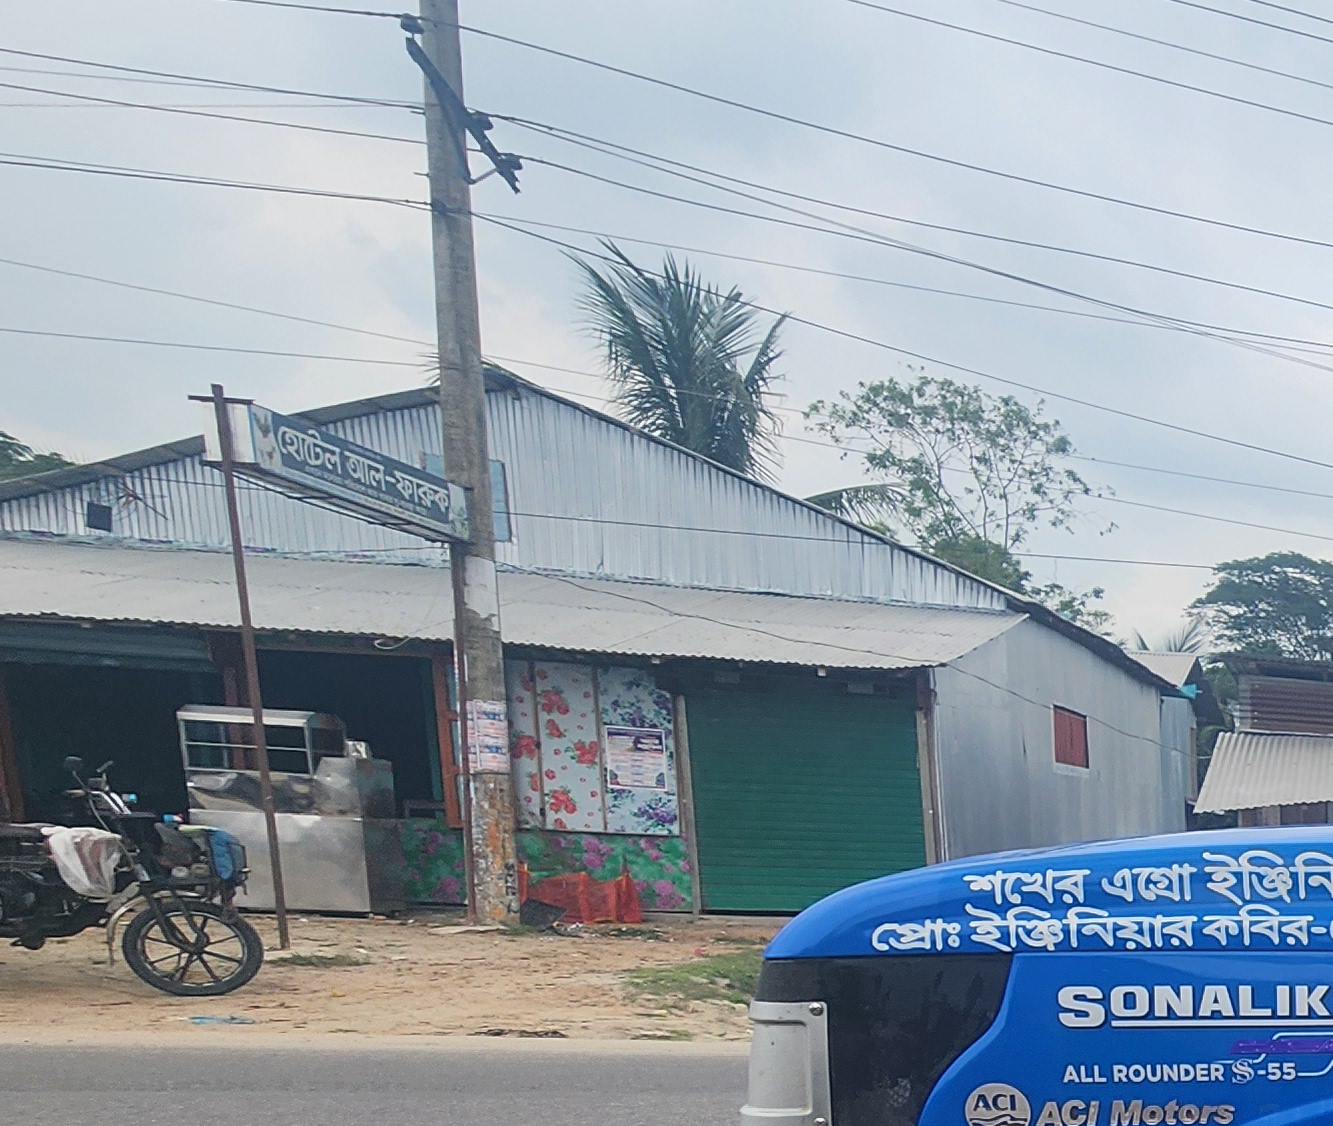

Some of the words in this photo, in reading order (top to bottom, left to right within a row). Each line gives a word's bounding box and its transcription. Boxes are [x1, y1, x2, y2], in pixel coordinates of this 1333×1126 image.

[277, 426, 341, 474] হোটেল
[344, 451, 449, 513] আল-ফারুক
[963, 869, 1091, 904] শখের
[1102, 862, 1197, 902] এগ্রো
[965, 903, 1198, 951] ইঞ্জিনিয়ার
[1063, 1064, 1107, 1083] ALL
[1113, 1063, 1224, 1083] ROUNDER
[972, 1093, 1017, 1113] ACI
[1110, 1099, 1236, 1126] Motors
